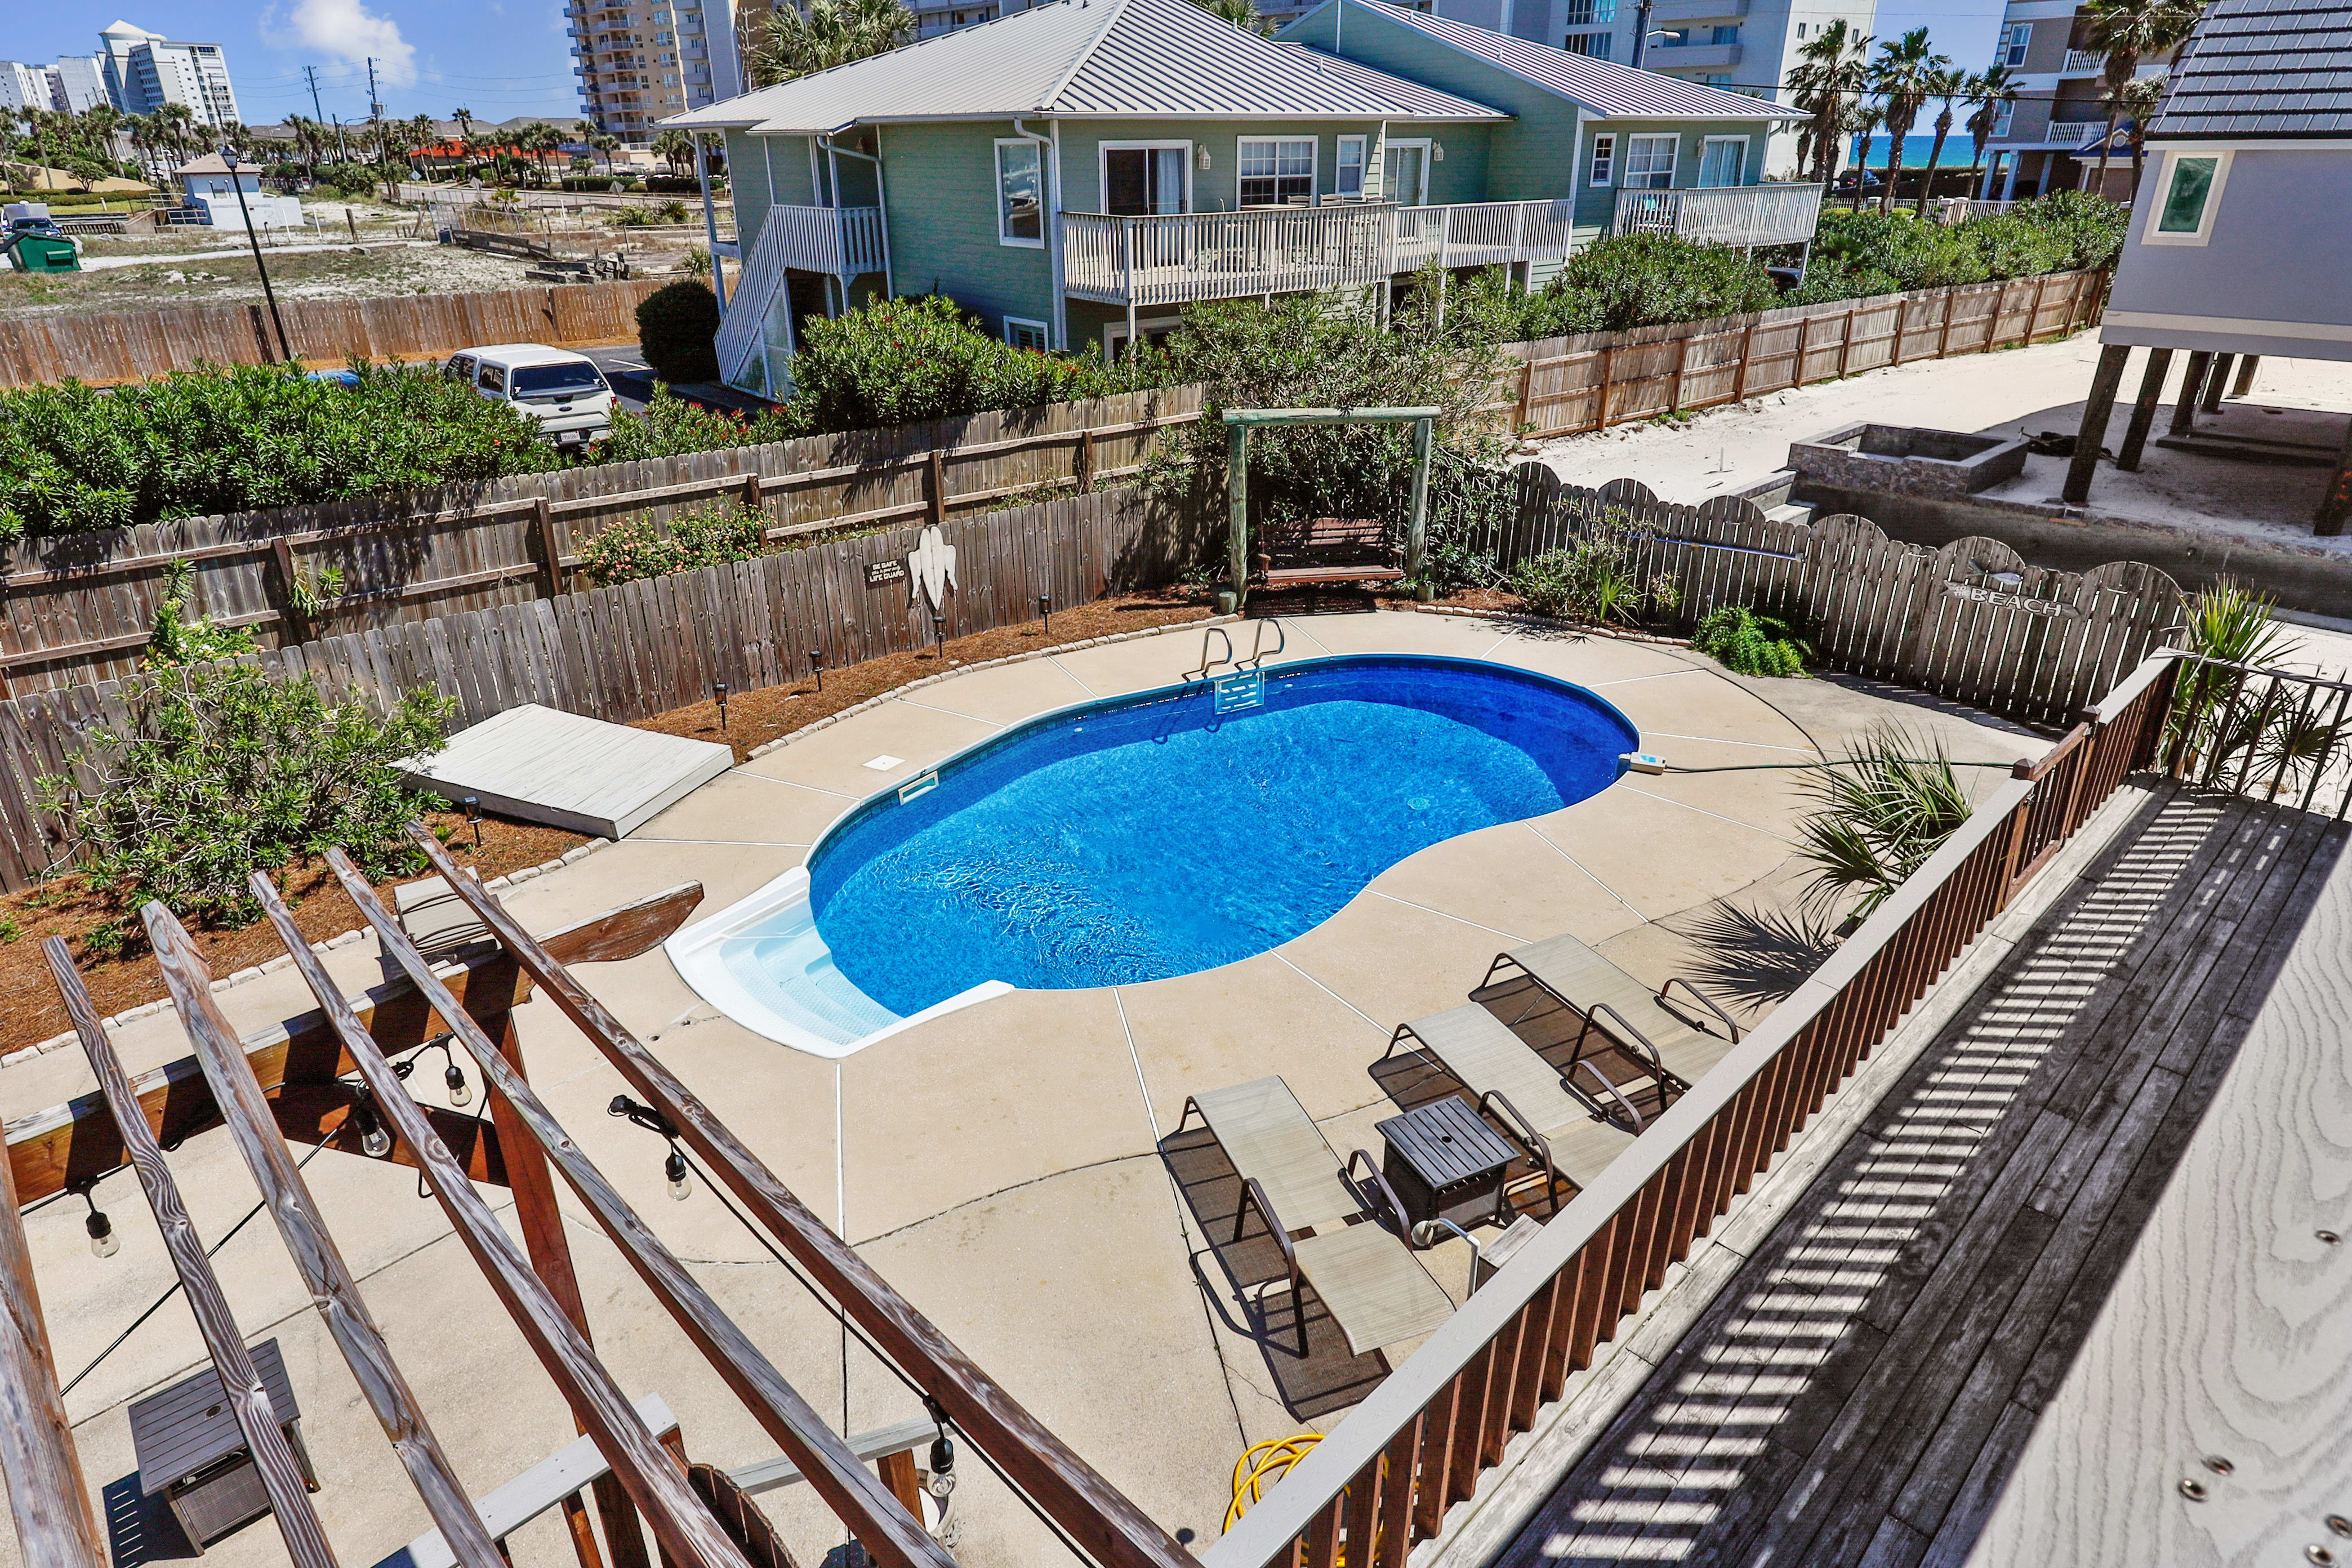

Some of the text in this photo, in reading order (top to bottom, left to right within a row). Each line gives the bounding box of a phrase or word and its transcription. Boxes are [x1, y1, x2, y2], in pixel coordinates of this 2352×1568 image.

[869, 569, 905, 582] LIFE GUARD
[1971, 588, 2062, 617] BEACH
